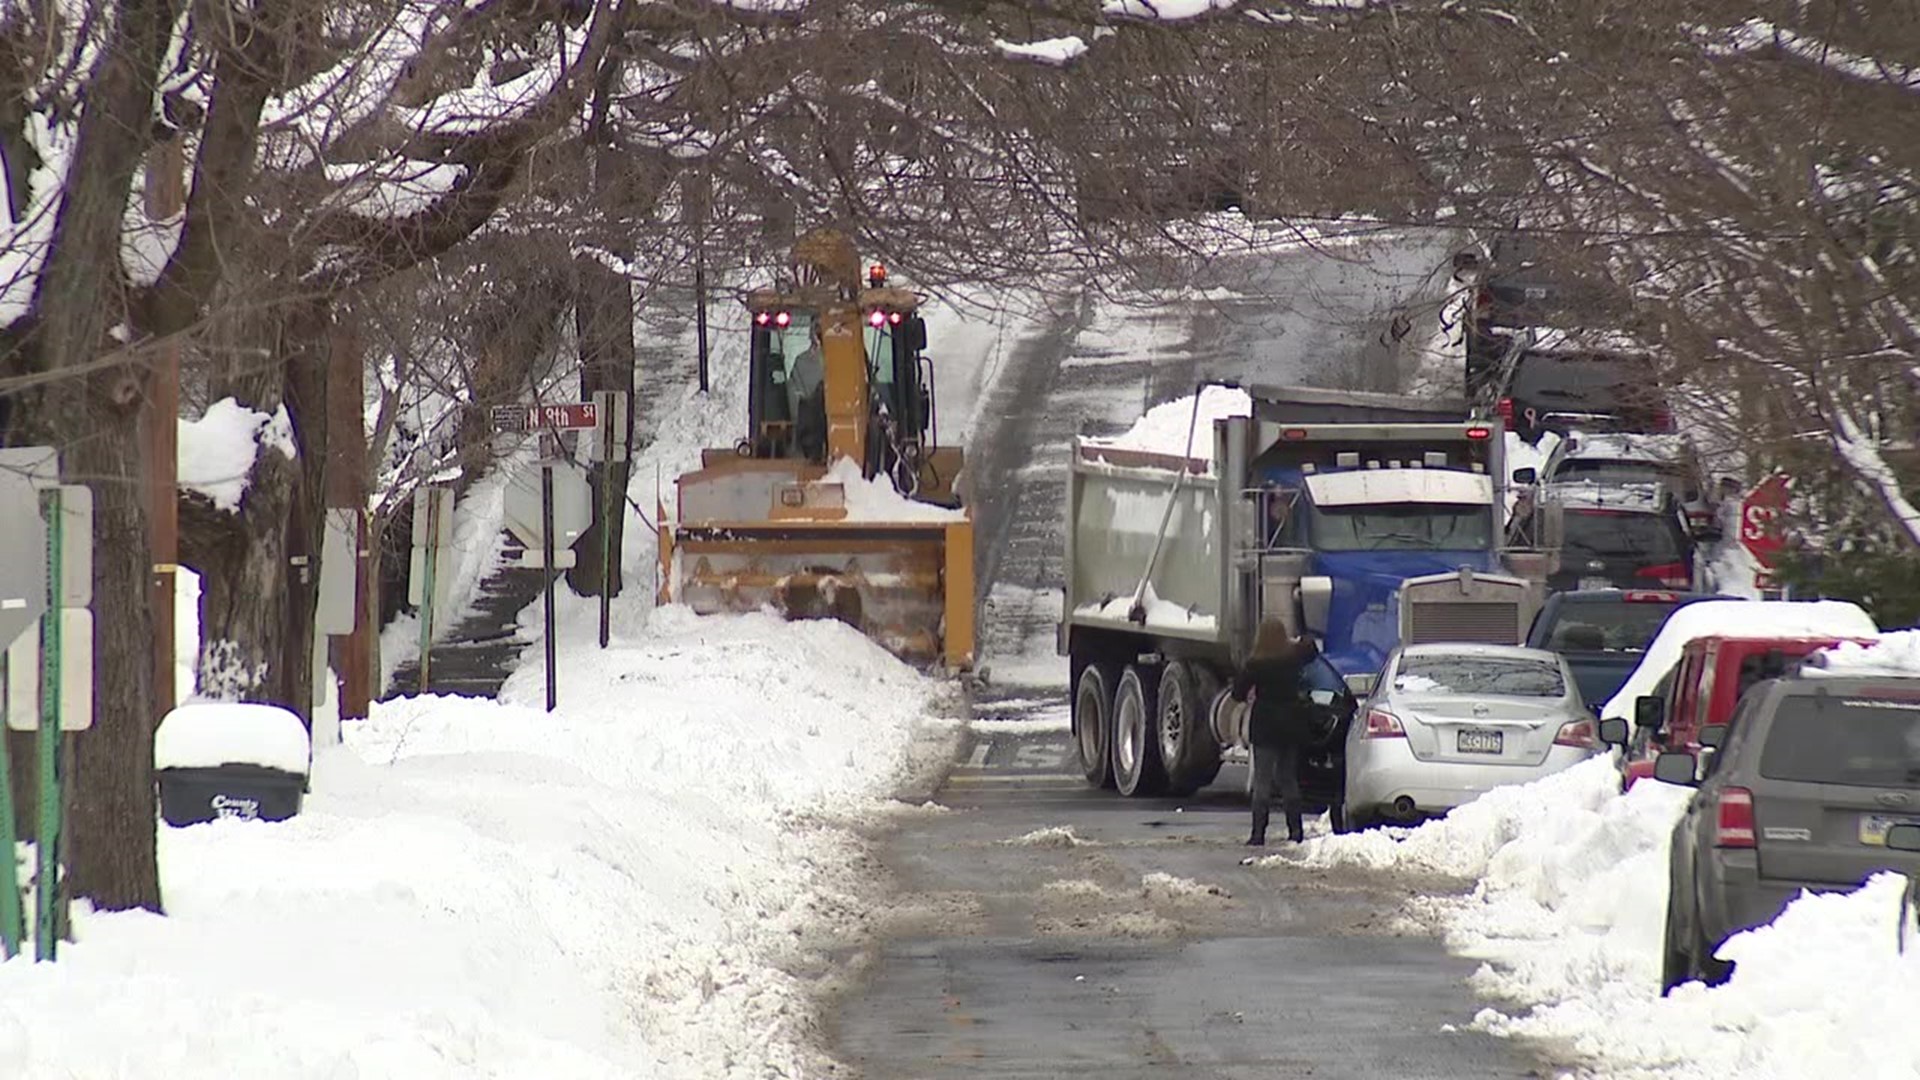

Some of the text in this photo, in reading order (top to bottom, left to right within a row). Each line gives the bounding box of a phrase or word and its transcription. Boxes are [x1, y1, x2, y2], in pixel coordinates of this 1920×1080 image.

[529, 408, 539, 427] N
[545, 407, 569, 427] 9th
[582, 405, 594, 418] St
[211, 794, 259, 811] County
